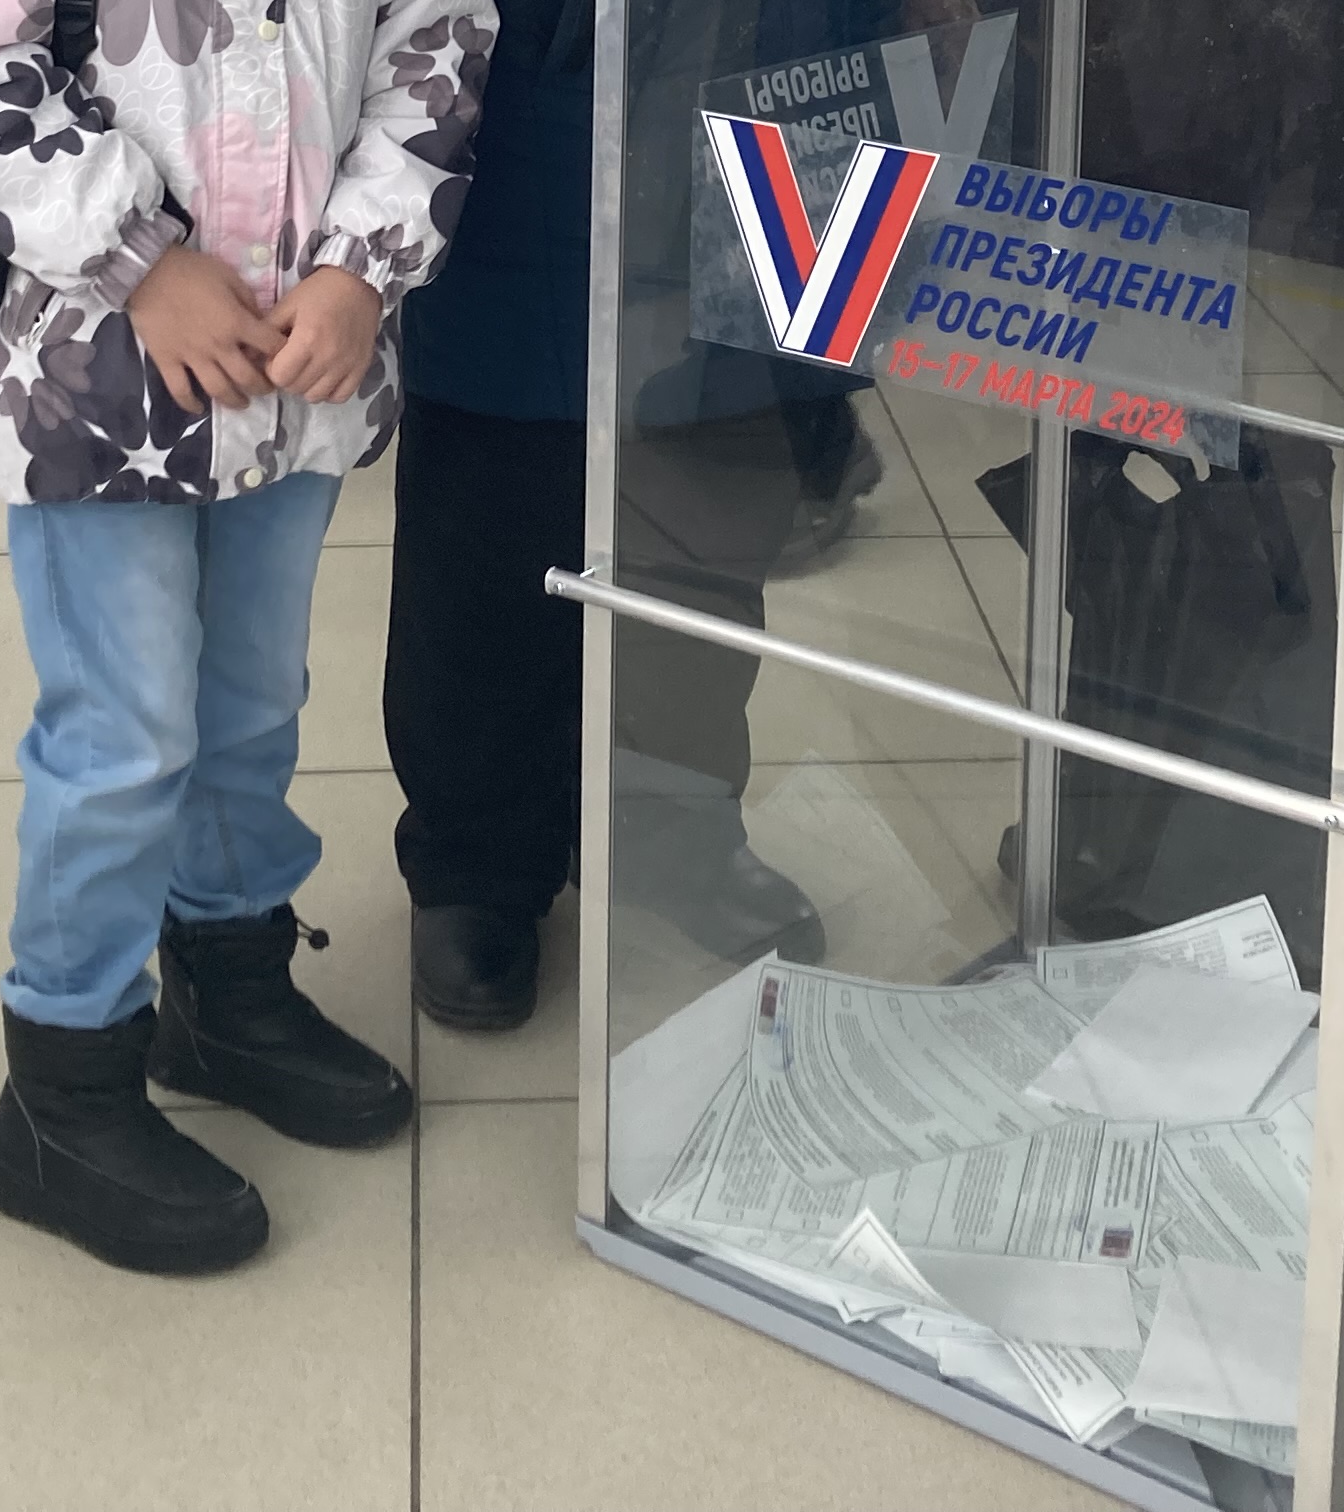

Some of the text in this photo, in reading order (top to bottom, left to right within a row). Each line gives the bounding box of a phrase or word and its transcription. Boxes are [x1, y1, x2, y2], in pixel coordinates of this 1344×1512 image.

[955, 163, 1174, 245] ВЫБОРЫ
[929, 224, 1236, 329] ПРЕЗИДЕНТА
[906, 284, 1099, 364] РОССИИ
[979, 360, 1096, 422] МАРТА
[1099, 391, 1185, 445] 2024
